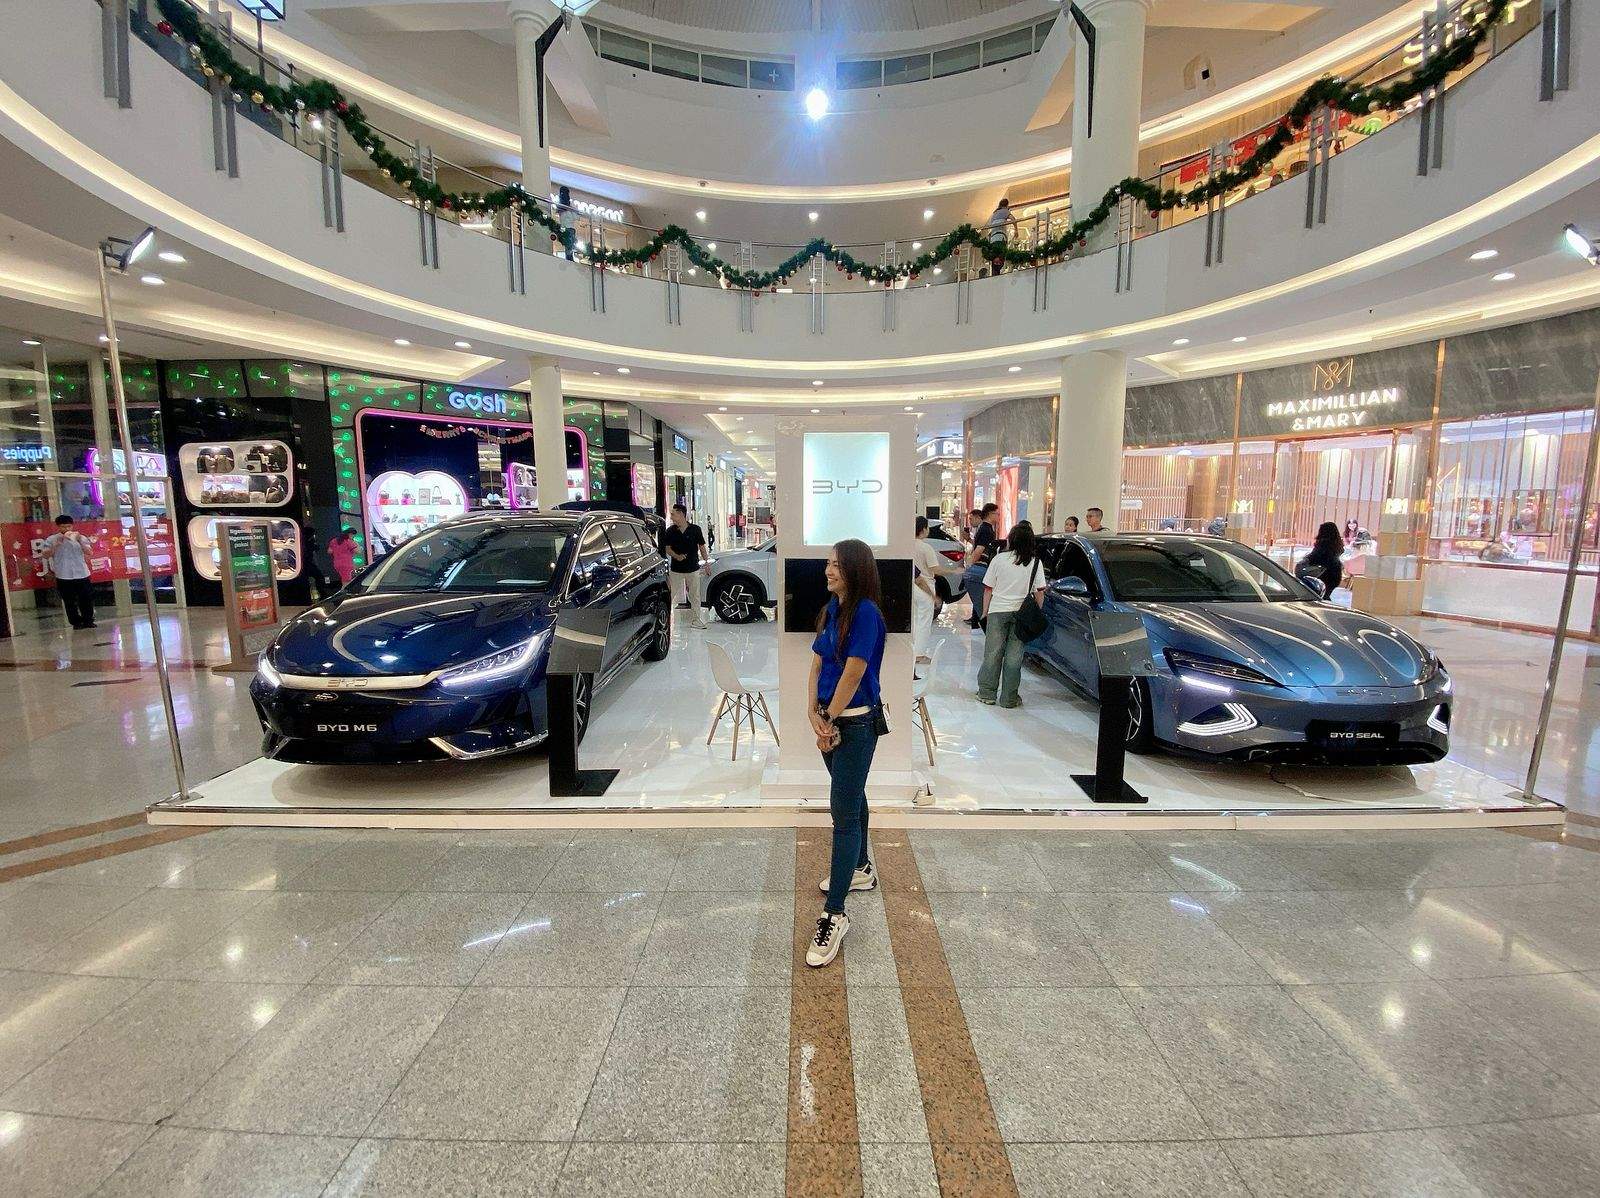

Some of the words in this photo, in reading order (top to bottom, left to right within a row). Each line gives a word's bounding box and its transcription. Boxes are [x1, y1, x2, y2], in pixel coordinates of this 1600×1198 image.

[1266, 387, 1398, 417] MAXIMILLIAN
[812, 479, 883, 494] BYD
[327, 679, 368, 687] BYD
[317, 724, 349, 732] BYD
[353, 724, 377, 732] M6
